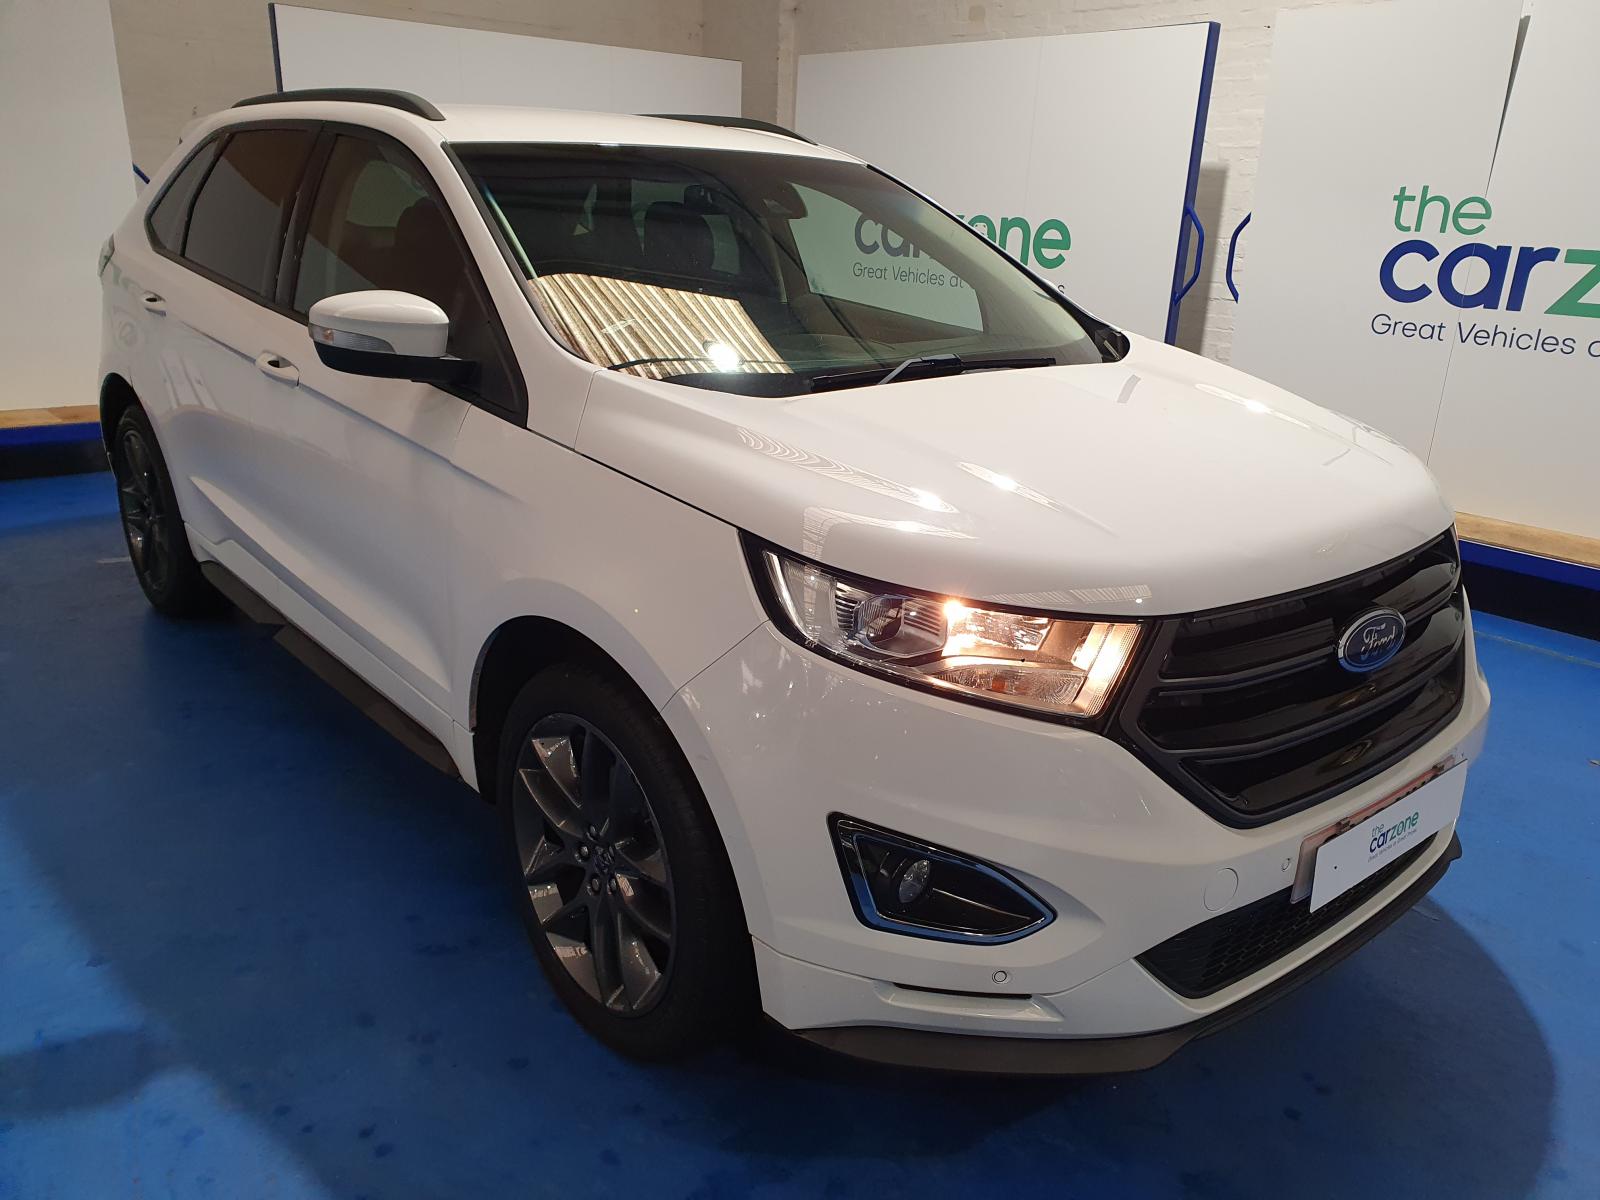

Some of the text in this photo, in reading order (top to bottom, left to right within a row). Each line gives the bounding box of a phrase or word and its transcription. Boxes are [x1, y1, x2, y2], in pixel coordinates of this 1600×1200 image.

[1393, 185, 1493, 235] the
[852, 262, 888, 281] Great
[892, 265, 945, 286] Vehicles
[1371, 313, 1447, 342] Great
[1457, 321, 1577, 355] Vehicles
[1361, 623, 1396, 660] Ford
[1369, 811, 1420, 853] carzone
